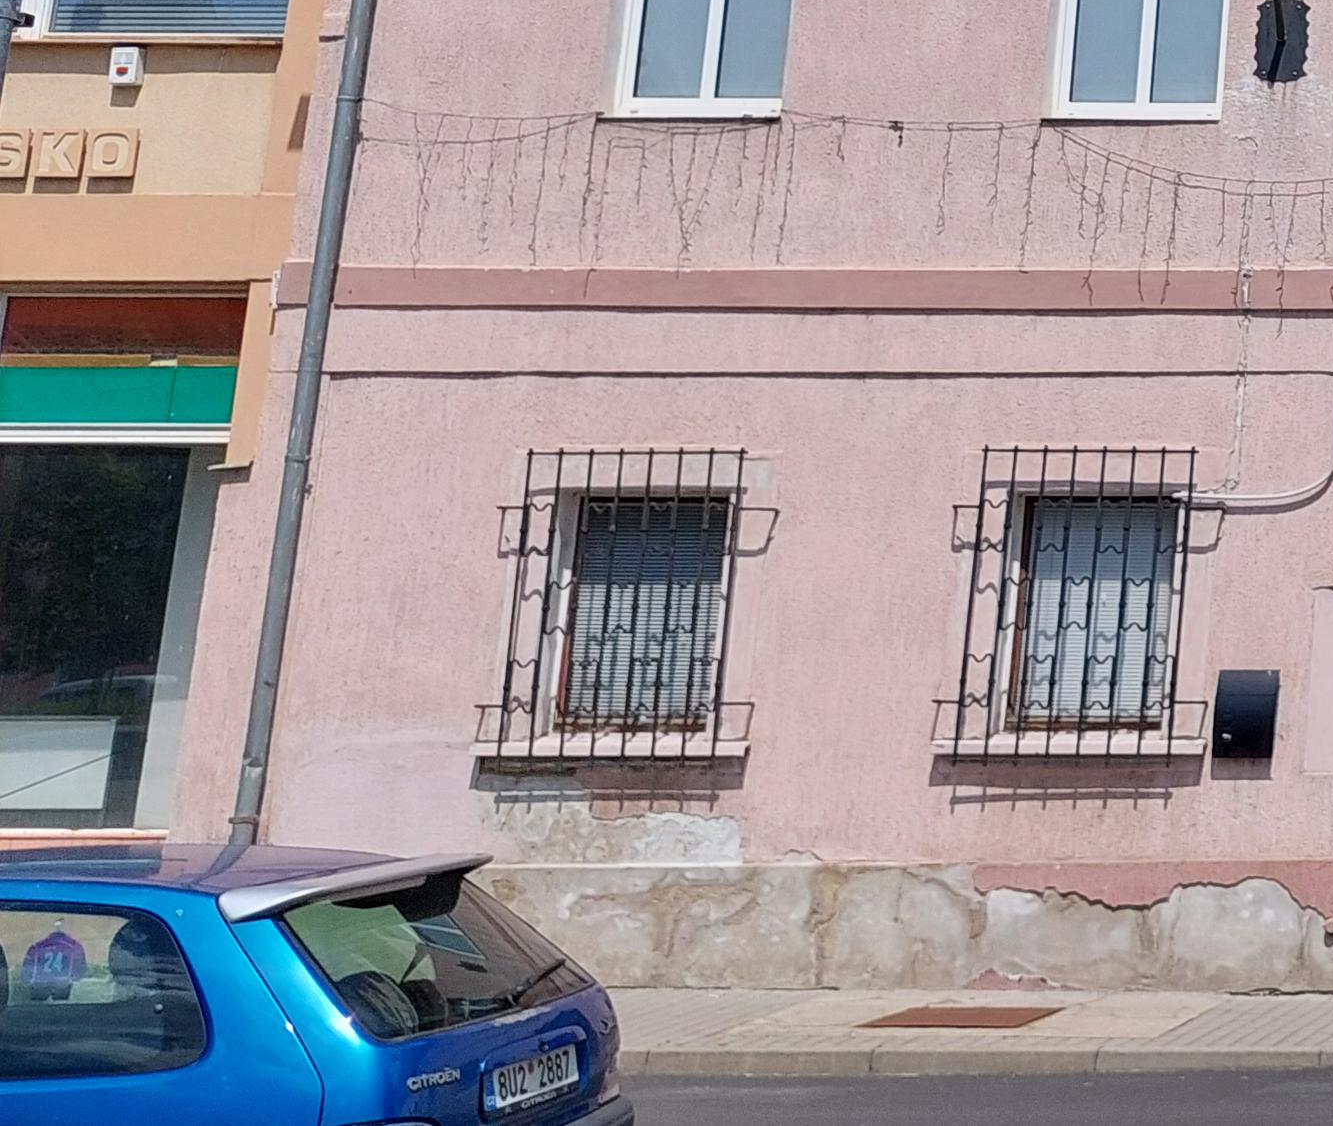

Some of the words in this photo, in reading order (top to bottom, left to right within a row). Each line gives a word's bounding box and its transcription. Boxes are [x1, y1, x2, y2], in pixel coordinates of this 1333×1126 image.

[43, 951, 64, 973] 24
[498, 1064, 529, 1102] 8U2
[537, 1049, 570, 1088] 2887
